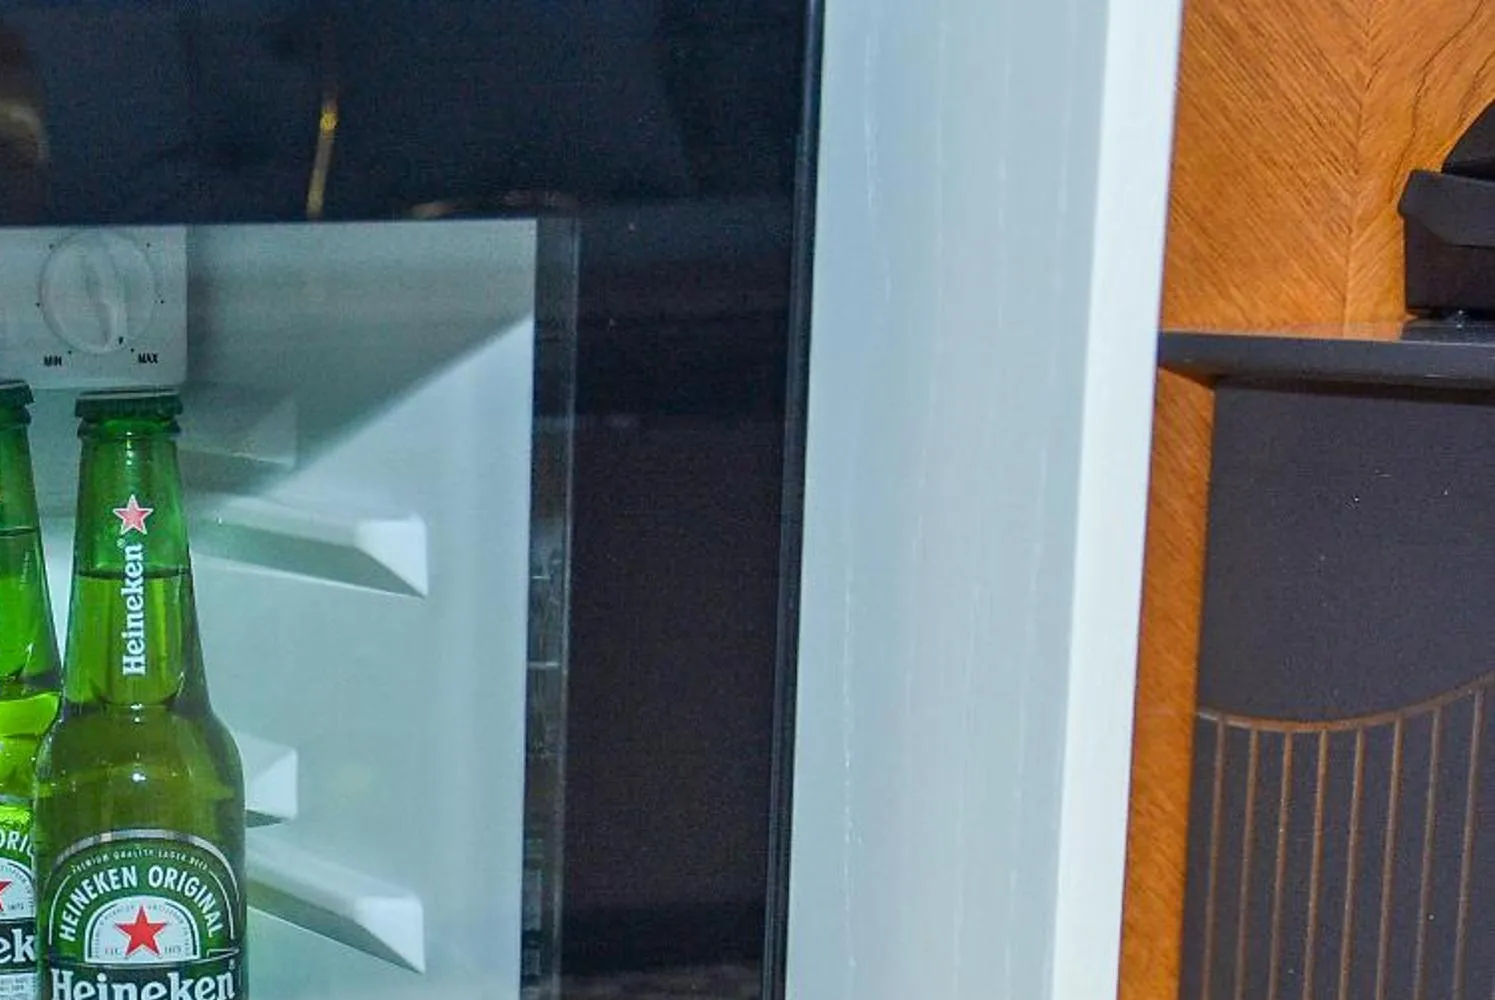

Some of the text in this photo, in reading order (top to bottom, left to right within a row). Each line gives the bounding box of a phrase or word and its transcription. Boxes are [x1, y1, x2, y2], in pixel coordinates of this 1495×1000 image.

[44, 355, 62, 367] MIN
[138, 353, 159, 365] MAX
[121, 543, 147, 676] Heineken
[59, 864, 223, 942] HEINEKEN ORIGINAL
